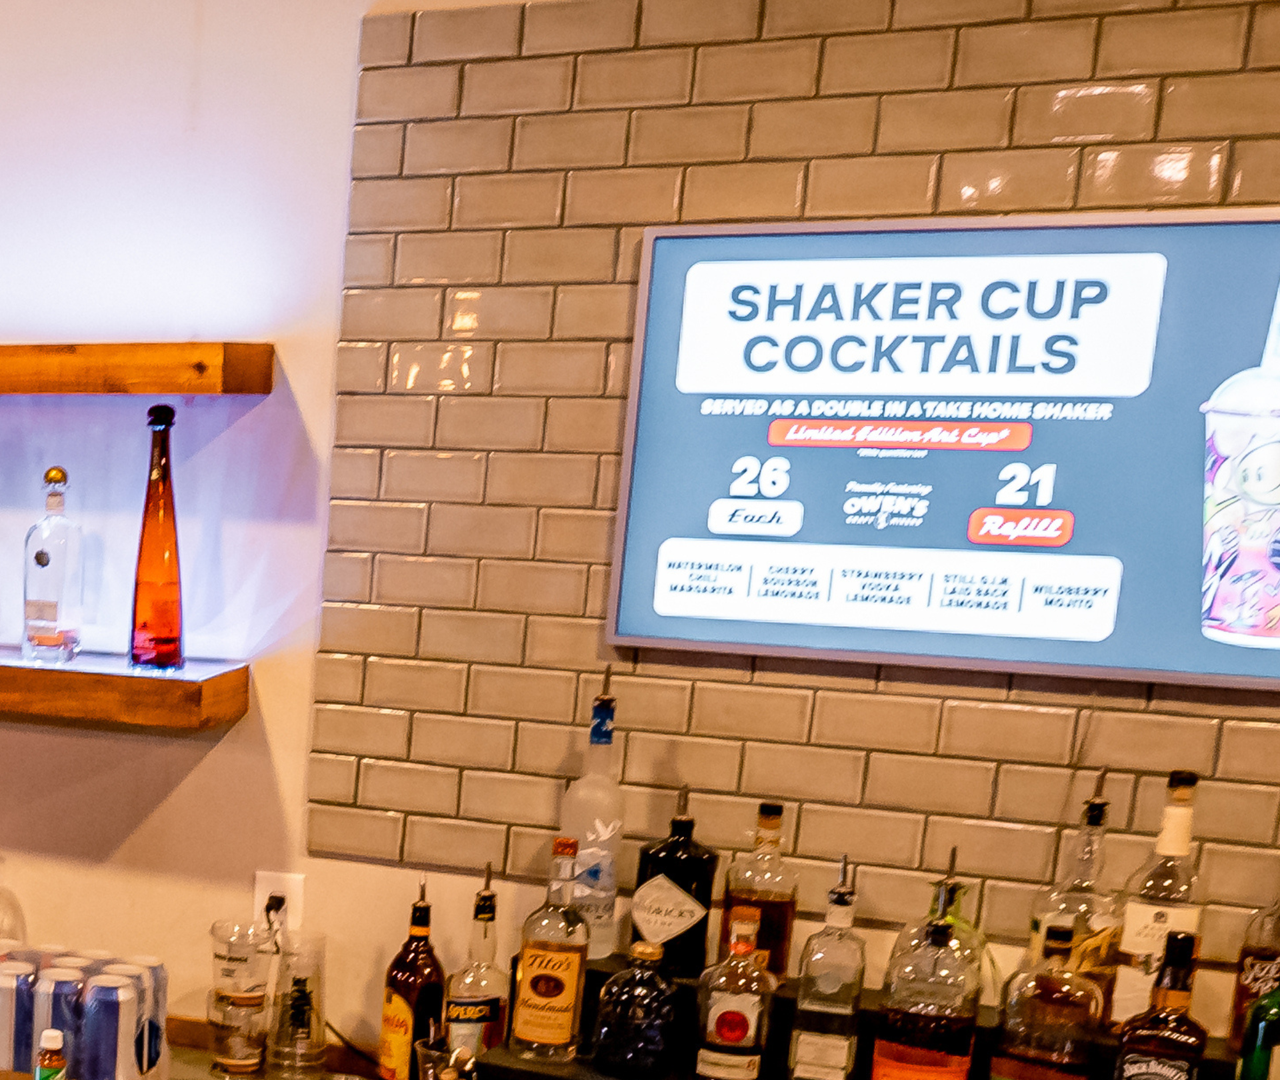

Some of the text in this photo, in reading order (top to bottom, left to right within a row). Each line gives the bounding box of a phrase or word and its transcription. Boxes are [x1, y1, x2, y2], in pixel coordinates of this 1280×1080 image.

[728, 279, 1110, 322] SHAKER CUP
[743, 335, 1079, 374] COCKTAILS
[700, 398, 1114, 420] SERVED AS A DOUBLE IN A TAKE HOME SHAKER
[785, 424, 856, 441] Limited
[854, 426, 922, 442] Edition
[729, 456, 792, 499] 26
[996, 462, 1057, 507] 21
[728, 508, 784, 524] Each
[843, 495, 930, 517] OWEN'S
[978, 515, 1064, 540] Refill
[667, 561, 743, 572] WATERMELON
[841, 569, 923, 581] STRAWBERRY
[527, 953, 572, 973] Tito's
